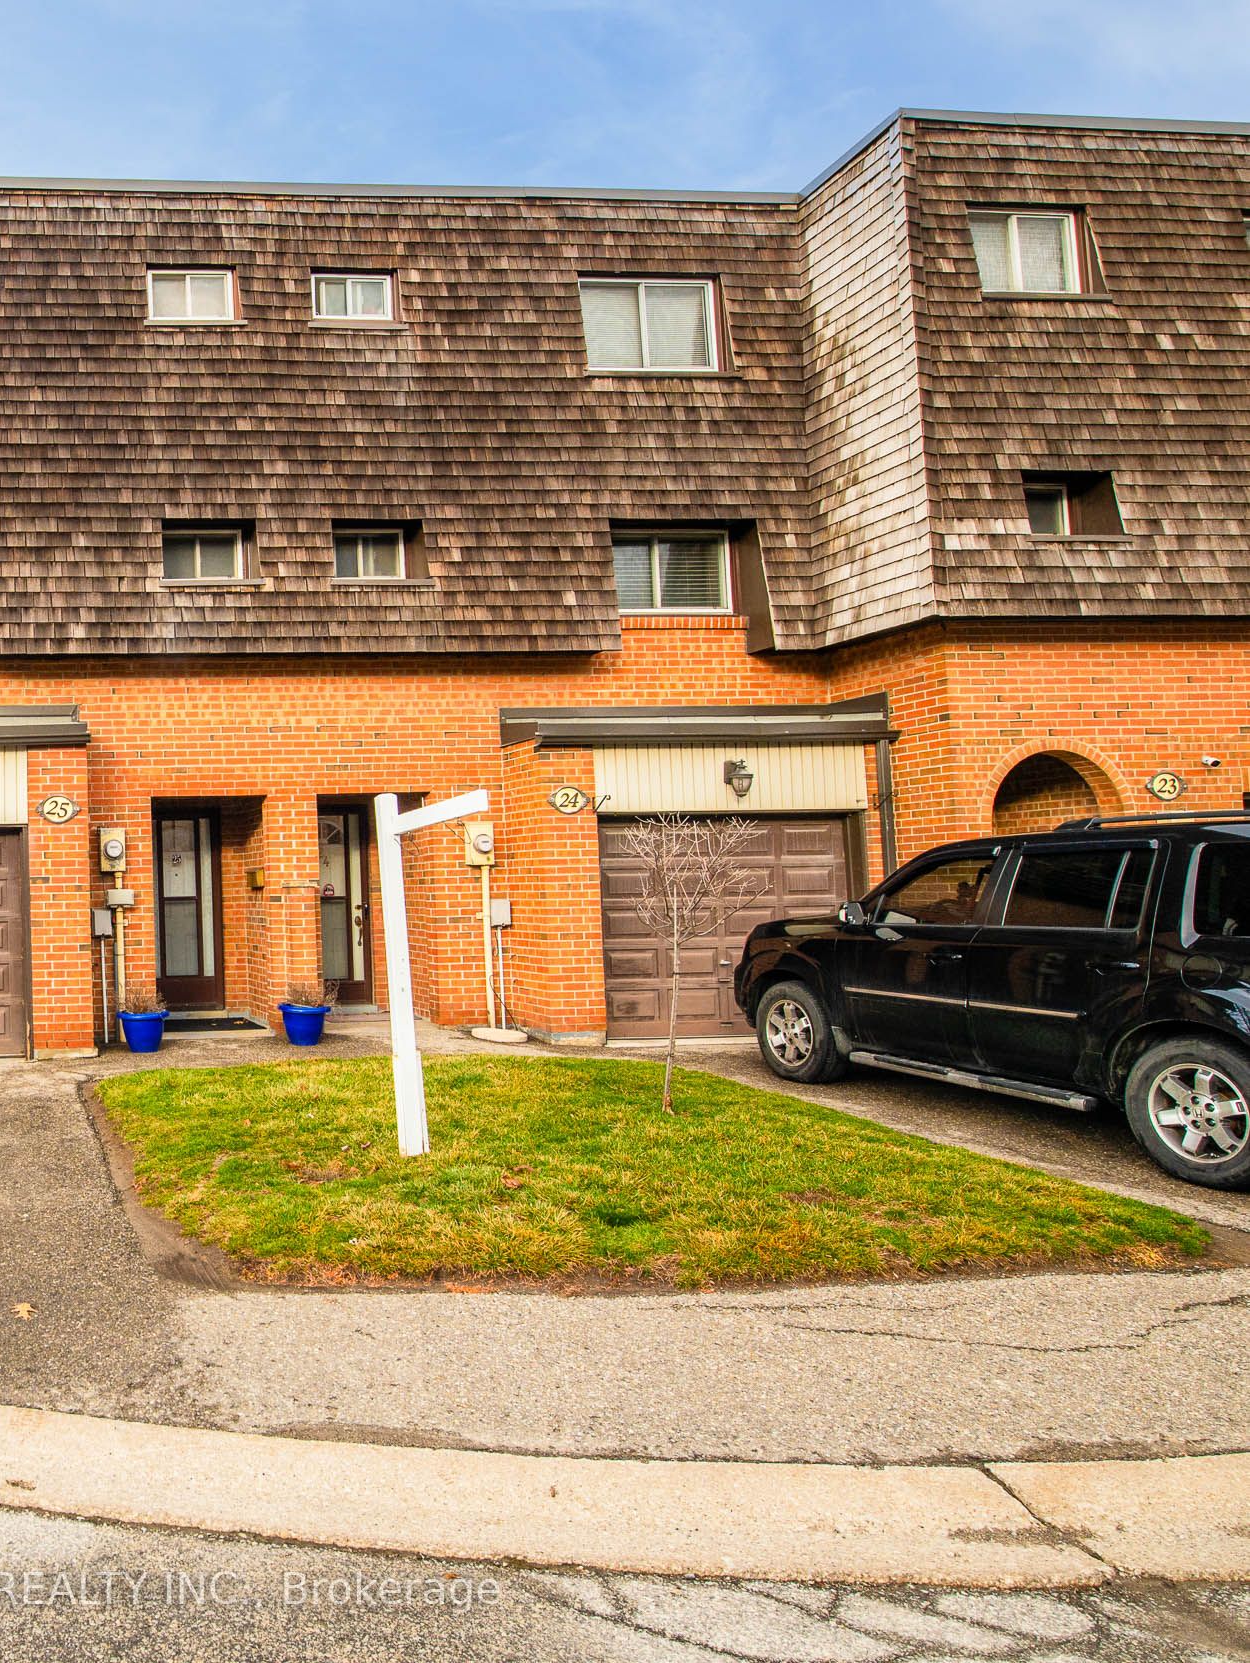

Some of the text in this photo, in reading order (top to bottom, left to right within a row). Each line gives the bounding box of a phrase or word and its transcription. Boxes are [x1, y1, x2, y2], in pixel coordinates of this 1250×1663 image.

[1157, 778, 1177, 794] 23
[559, 792, 579, 808] 24
[46, 800, 69, 818] 25
